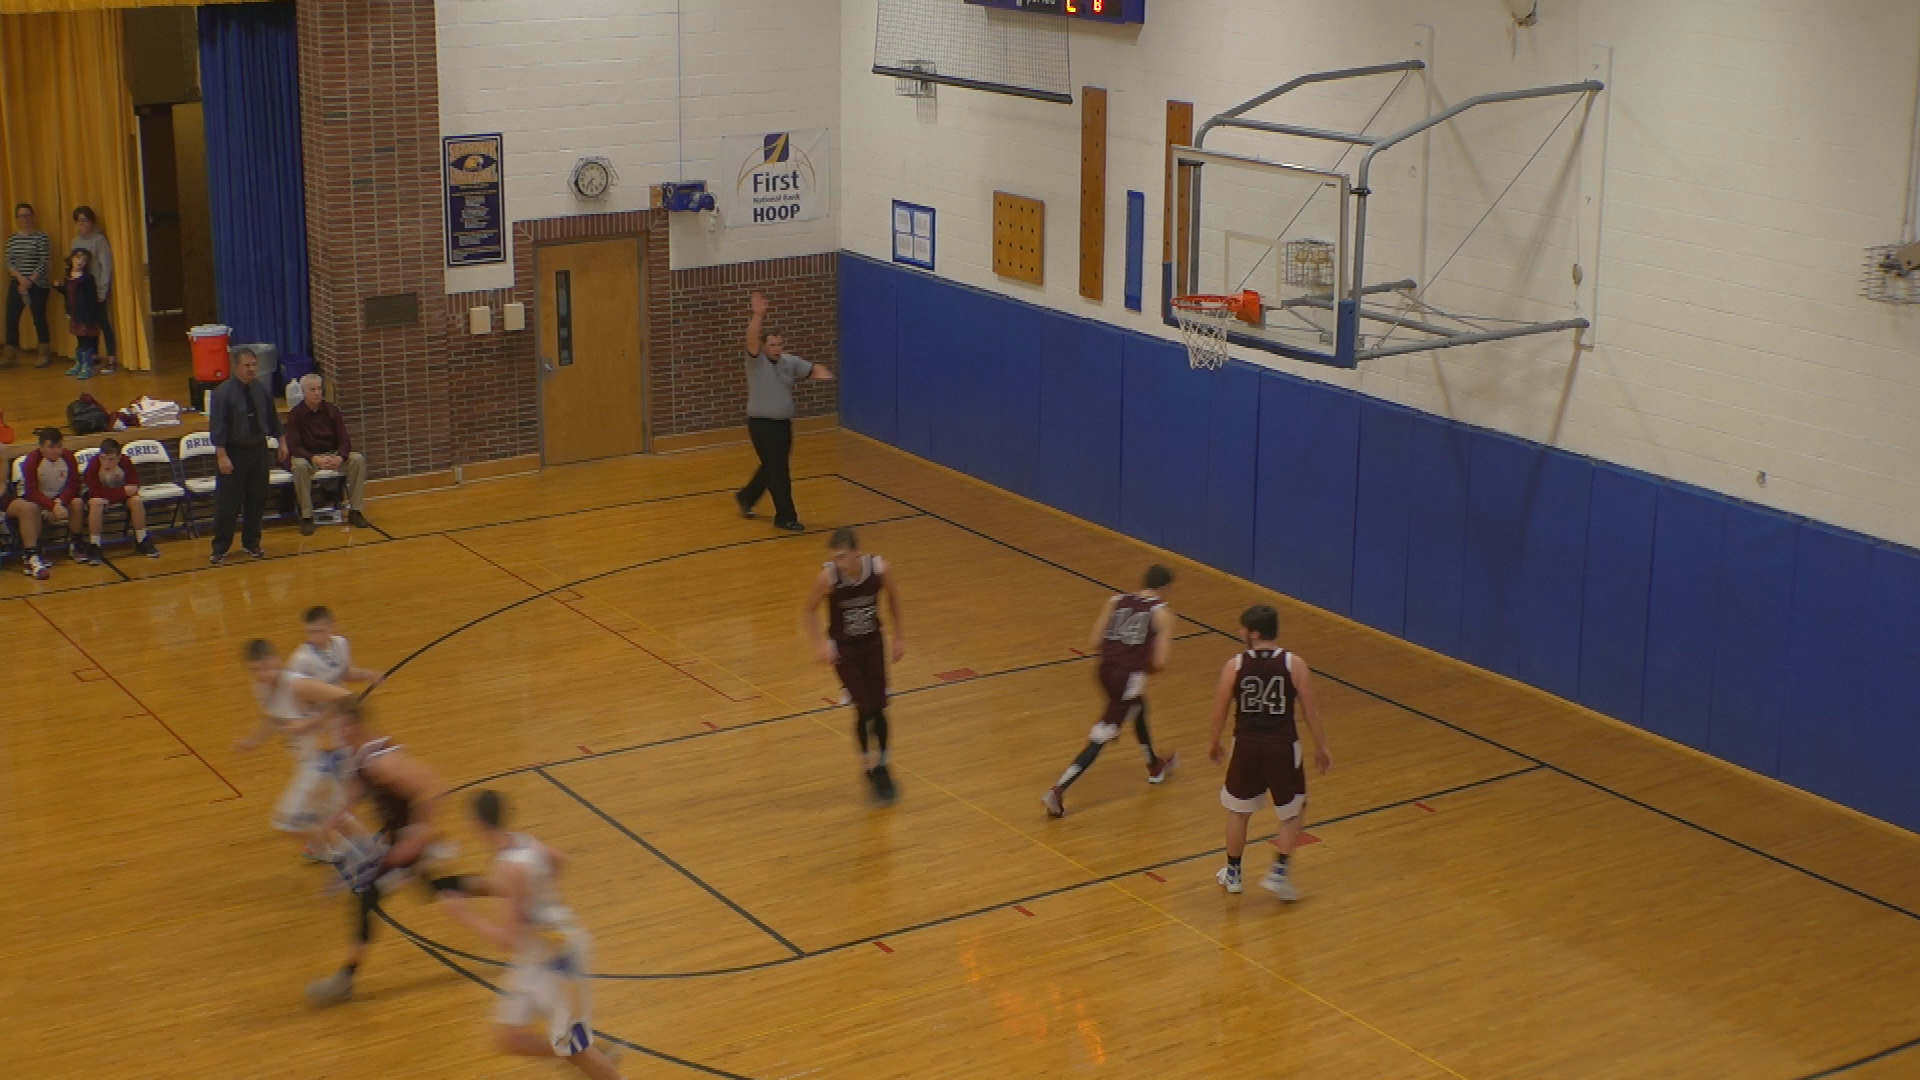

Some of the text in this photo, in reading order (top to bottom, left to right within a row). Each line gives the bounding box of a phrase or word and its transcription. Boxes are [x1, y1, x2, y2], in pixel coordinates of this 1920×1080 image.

[753, 170, 799, 193] First
[753, 204, 800, 222] HOOP
[1240, 676, 1286, 714] 24
